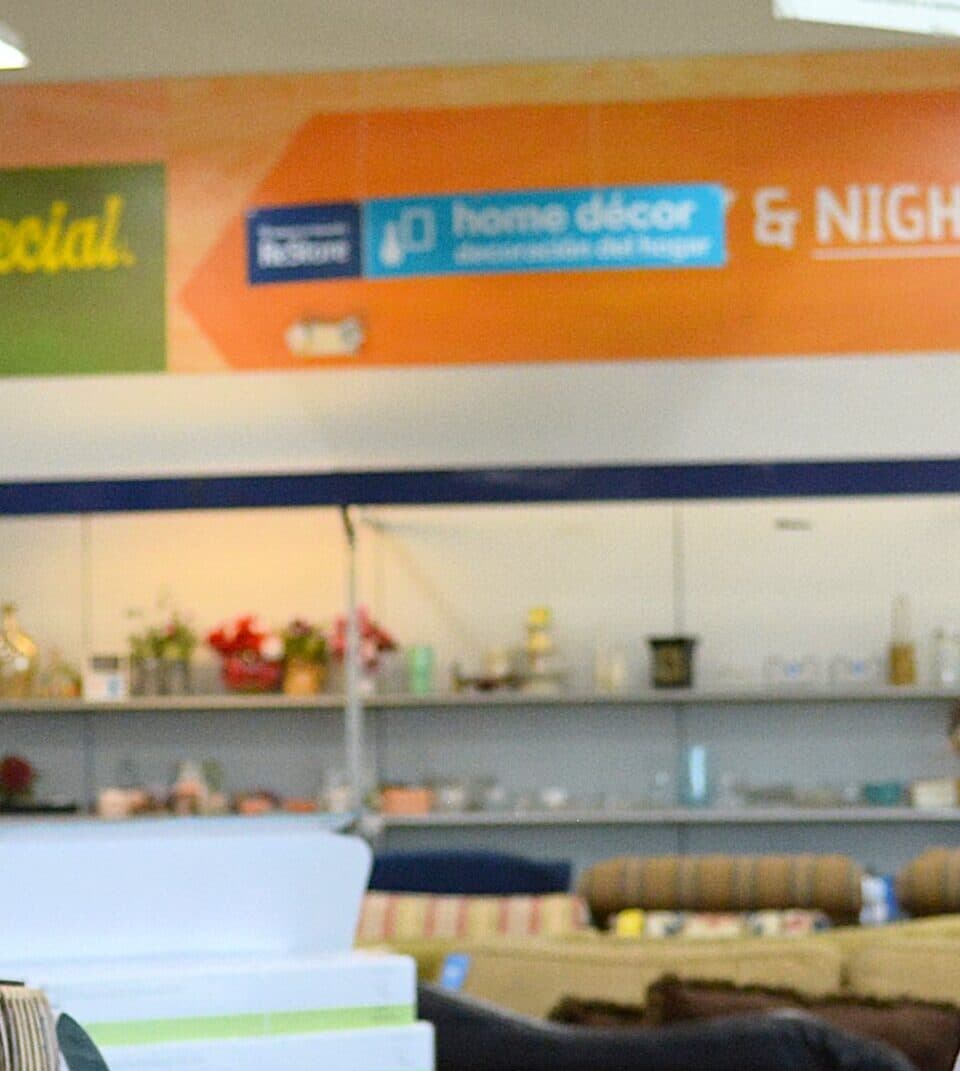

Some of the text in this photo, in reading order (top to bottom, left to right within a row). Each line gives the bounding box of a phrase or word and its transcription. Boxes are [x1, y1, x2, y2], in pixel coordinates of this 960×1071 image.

[452, 190, 695, 238] home décor
[753, 186, 800, 249] &
